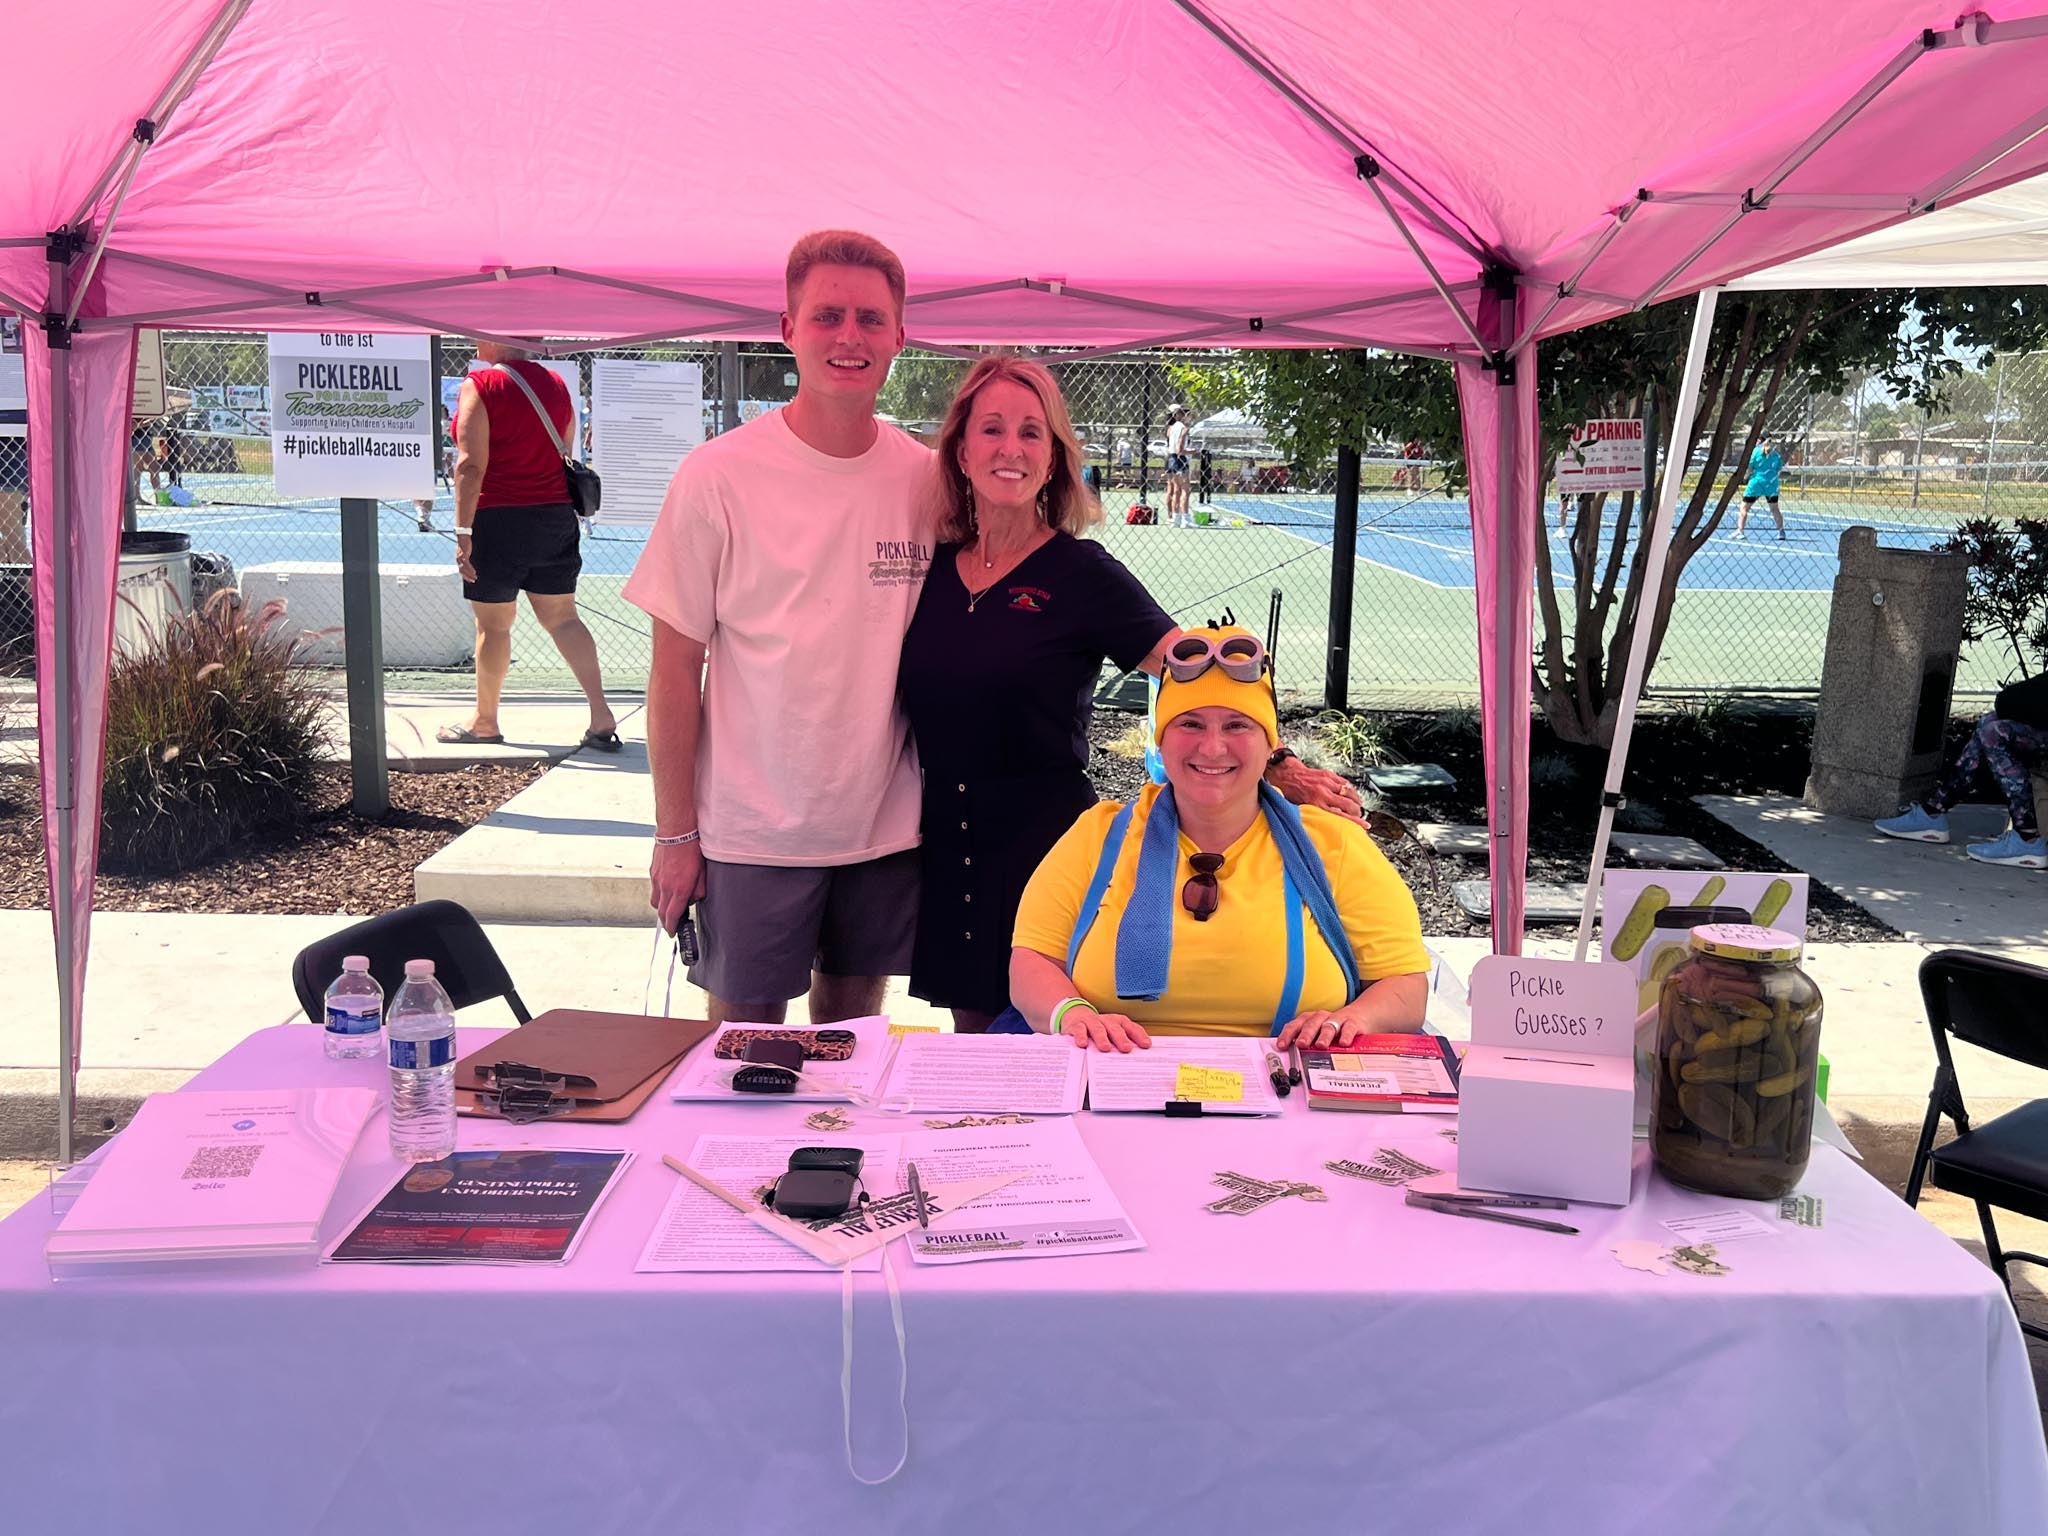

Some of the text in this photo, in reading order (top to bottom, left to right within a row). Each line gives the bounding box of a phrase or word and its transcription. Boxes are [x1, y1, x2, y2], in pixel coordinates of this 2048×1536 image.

[320, 334, 374, 348] to the 1st
[298, 363, 403, 391] PICKLEBALL
[316, 390, 388, 402] FOR A CAUSE
[285, 392, 424, 419] Tournament
[290, 417, 415, 430] Supporting Valley Children's Hospital
[1586, 422, 1642, 440] PARKING
[284, 434, 420, 459] #pickleball4acause
[1585, 466, 1607, 476] ENTIRE
[876, 541, 930, 561] PICKLEALL
[1510, 970, 1565, 998] Pickle
[1515, 1007, 1604, 1036] Guesses ?
[933, 1142, 1032, 1153] TOURNAMENT SCHEDULE
[1338, 1159, 1398, 1176] PICKLEBALL
[526, 1180, 582, 1188] POLICE
[925, 1231, 1010, 1244] PICKLEBALL
[1036, 1233, 1124, 1246] #pickleball4acause
